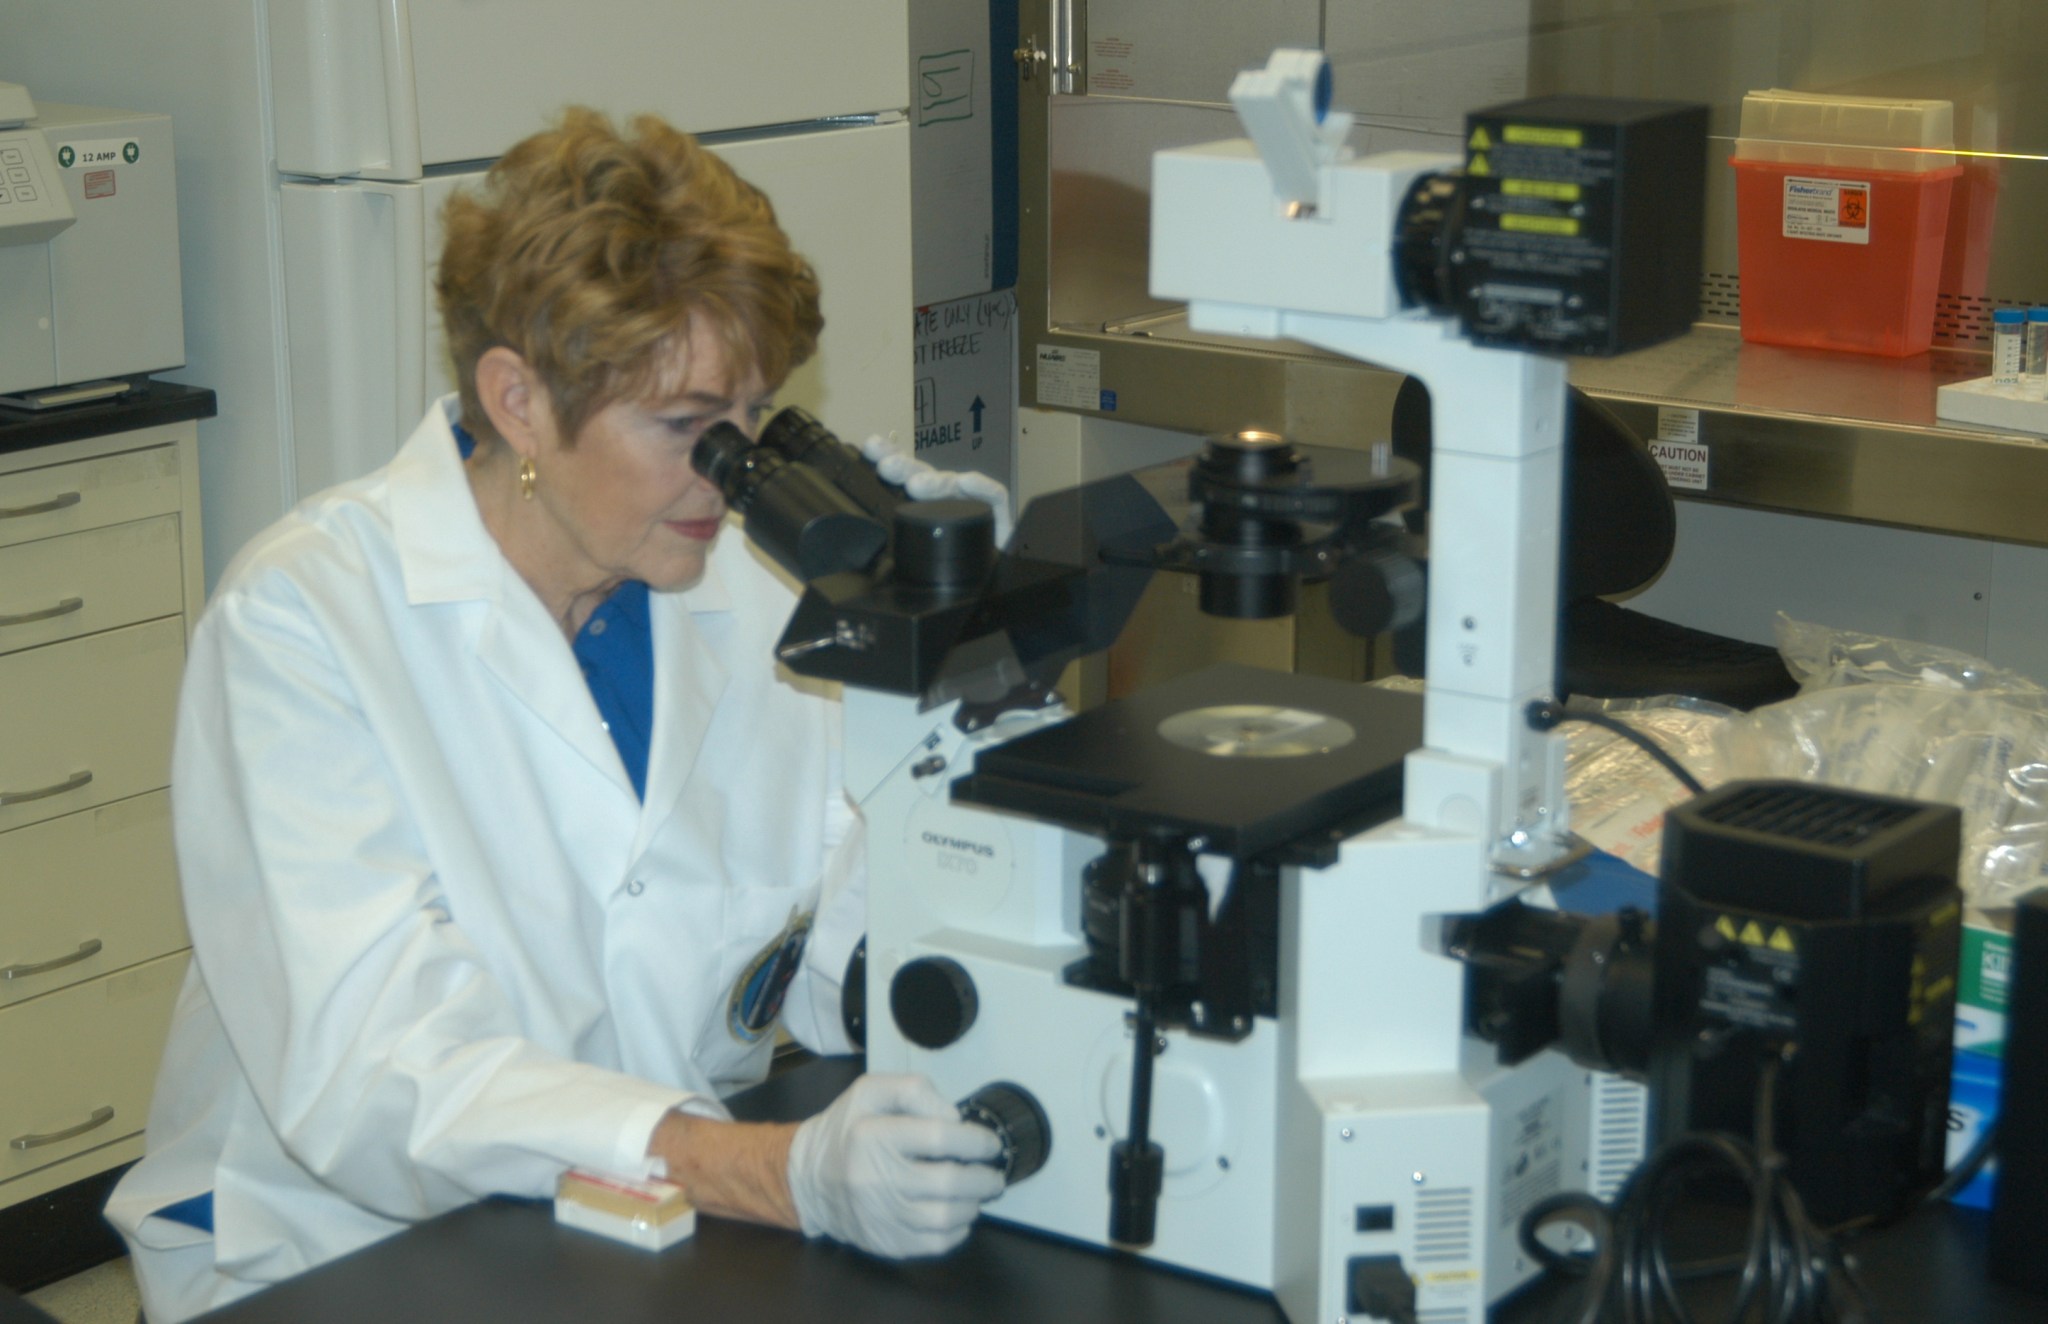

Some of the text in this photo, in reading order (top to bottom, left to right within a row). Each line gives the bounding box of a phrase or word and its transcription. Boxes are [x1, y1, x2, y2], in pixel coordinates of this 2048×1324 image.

[82, 152, 116, 162] 12 AMP
[931, 331, 984, 361] FREEZE
[972, 437, 983, 450] UP
[1649, 444, 1706, 463] CAUTION
[921, 831, 994, 857] OLYMPUS
